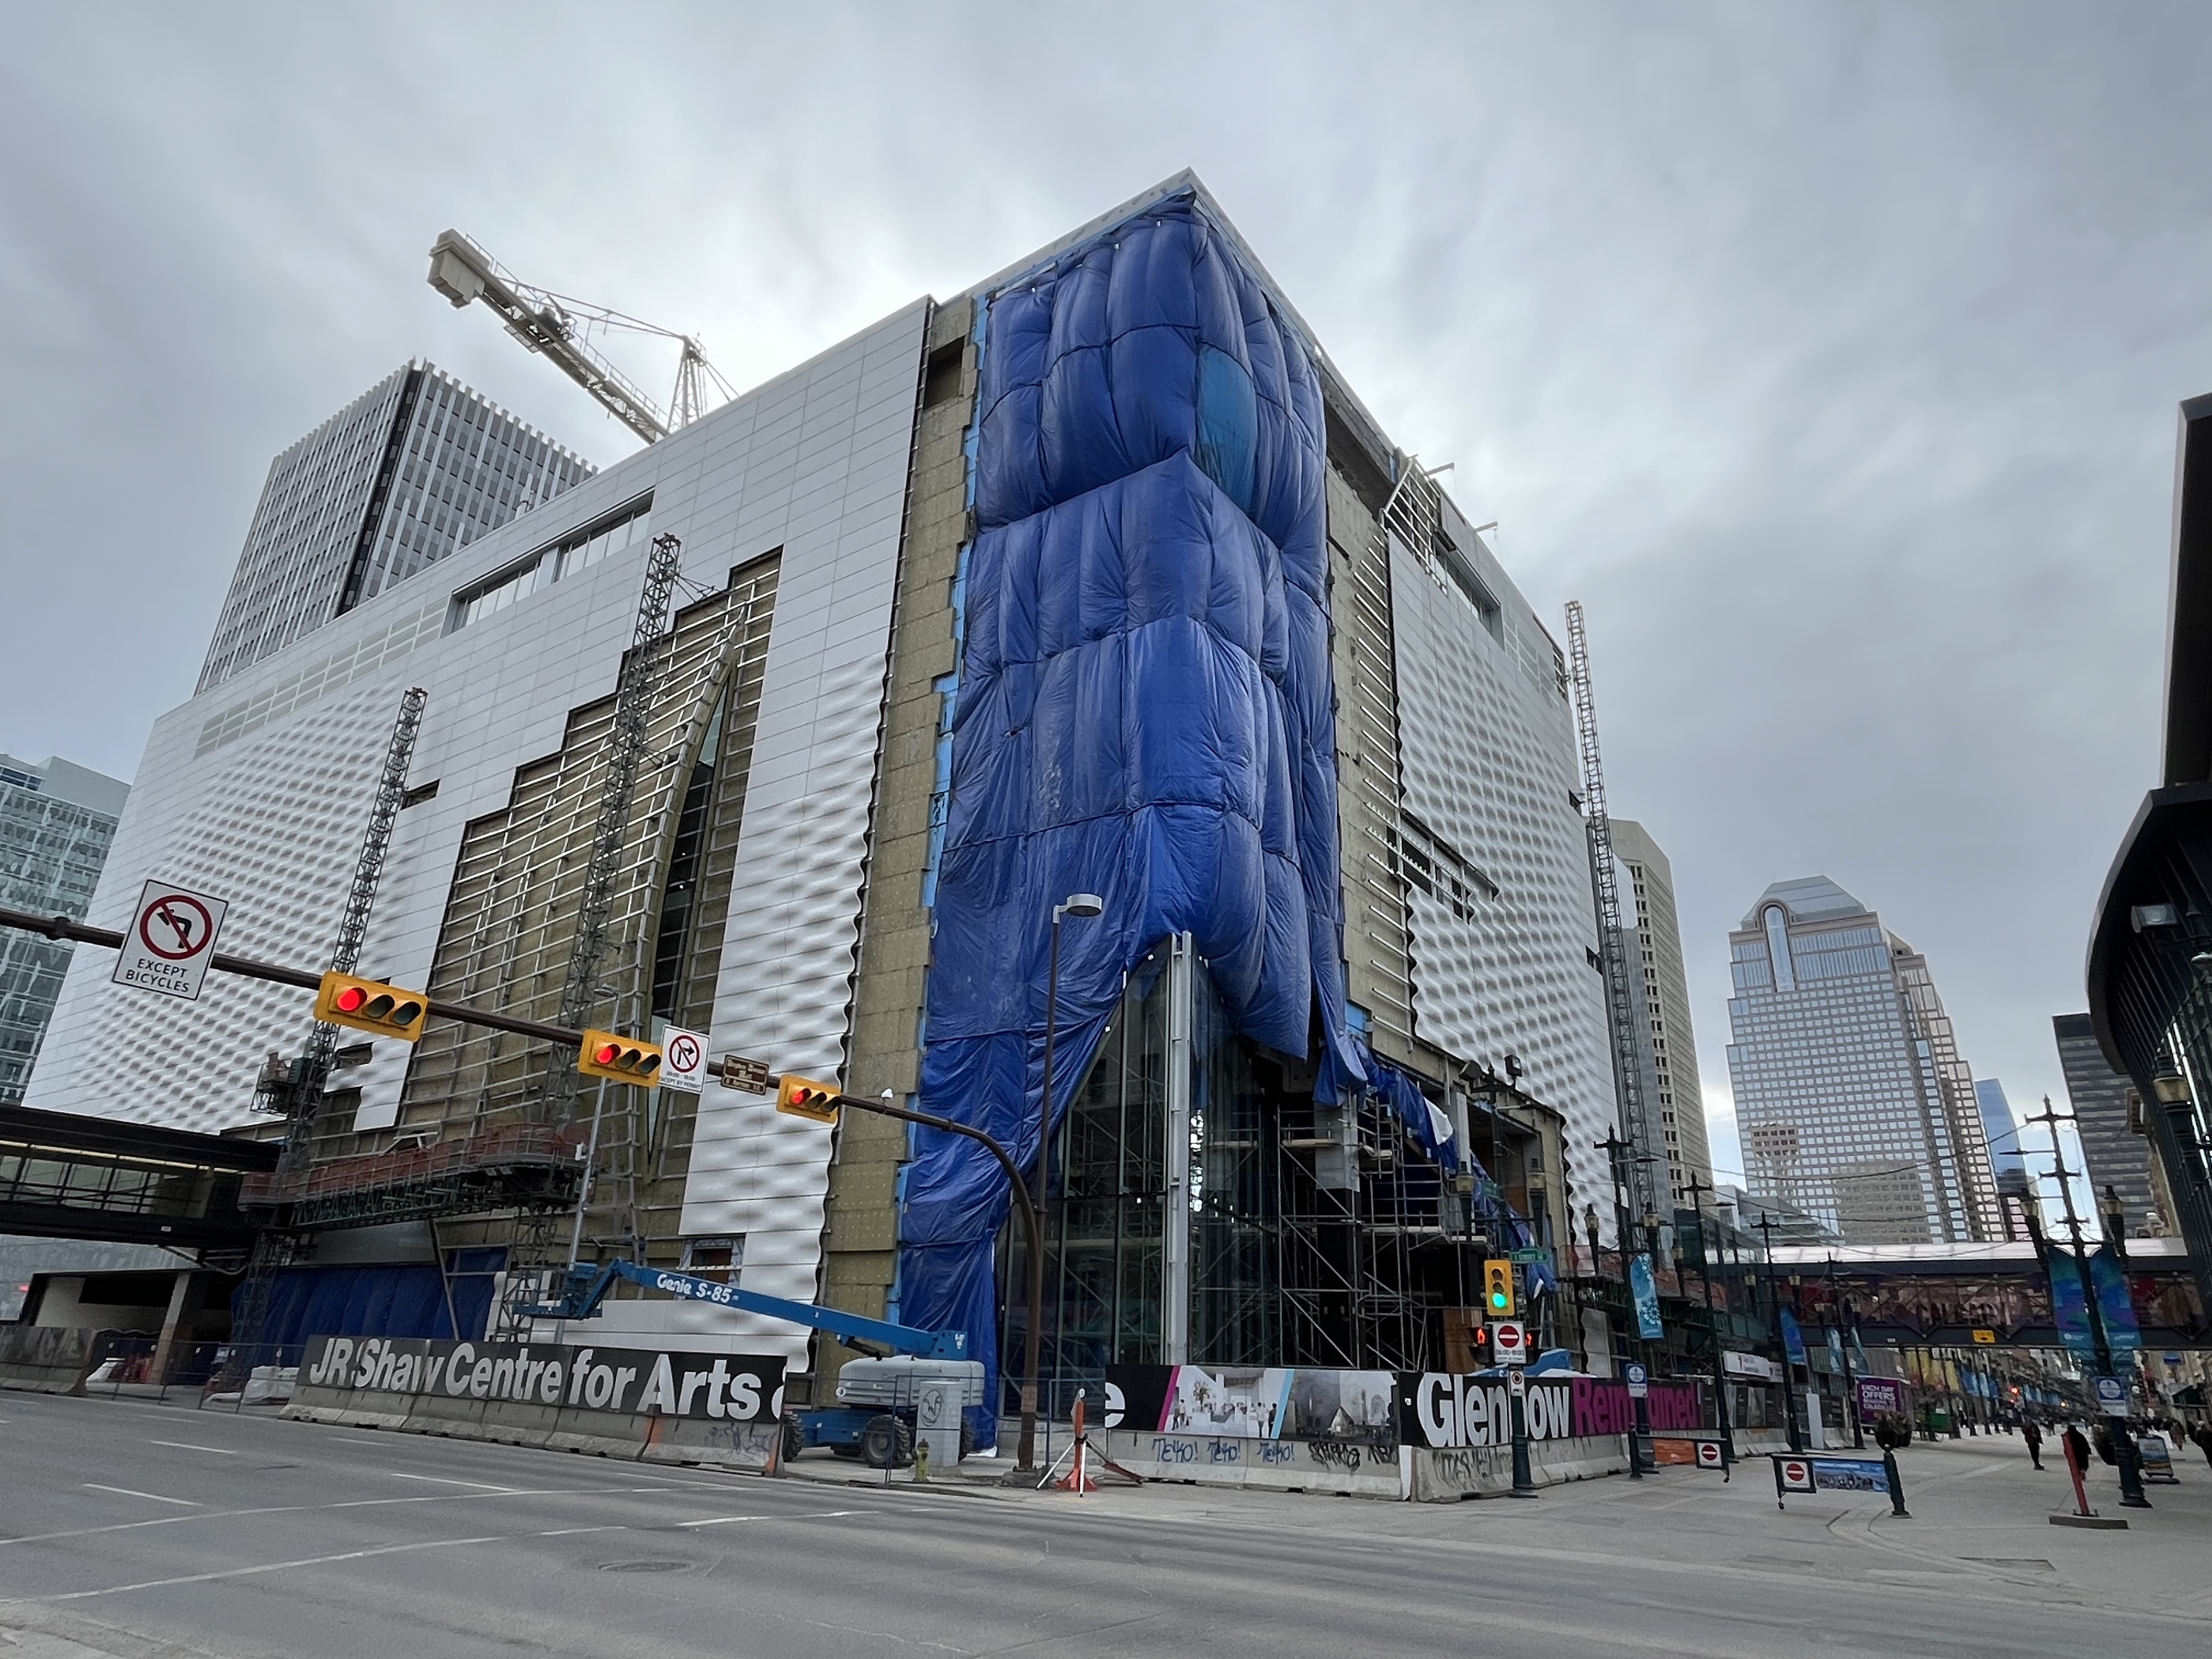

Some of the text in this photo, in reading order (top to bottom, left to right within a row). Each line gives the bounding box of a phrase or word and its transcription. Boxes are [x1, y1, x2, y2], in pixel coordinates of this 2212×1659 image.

[126, 969, 190, 992] BICYCLES
[137, 958, 188, 978] EXCEPT
[657, 1273, 733, 1304] Genie S-85
[309, 1338, 353, 1386] JR
[351, 1338, 445, 1392] Shaw
[445, 1342, 562, 1403] Centre
[568, 1348, 637, 1409] for
[636, 1353, 761, 1420] Arts
